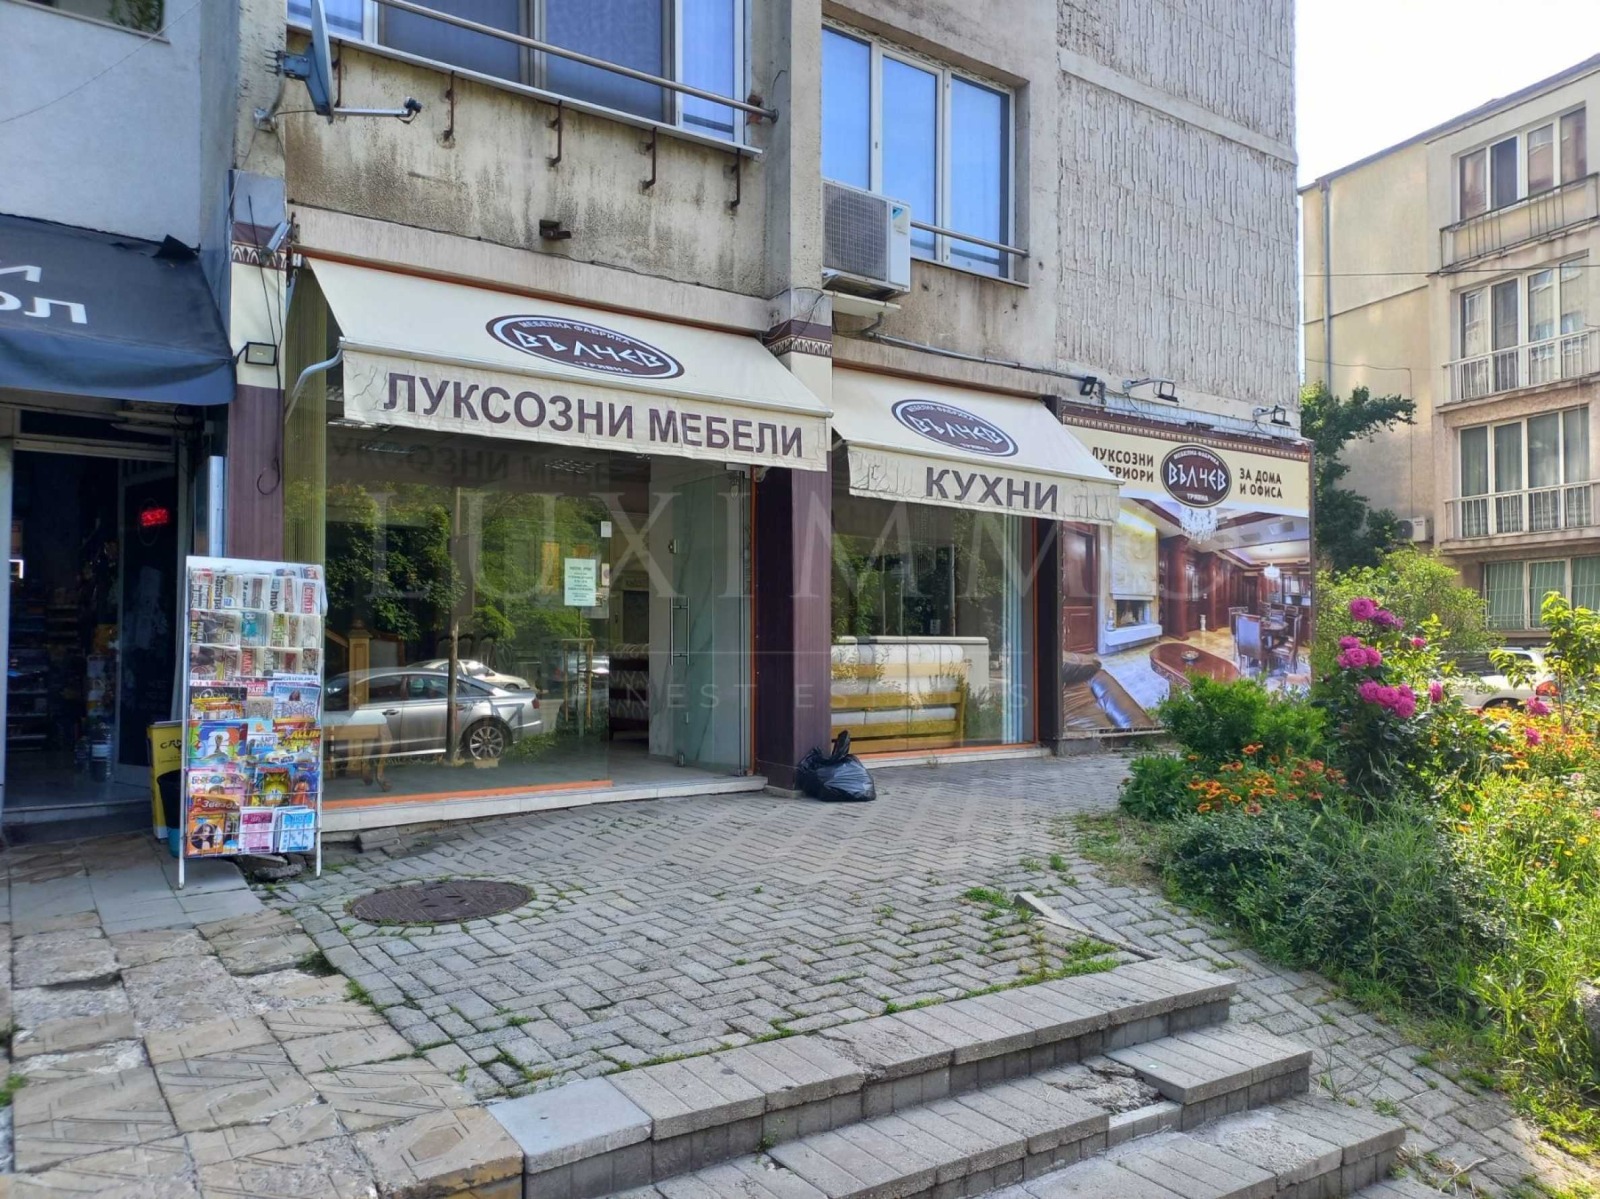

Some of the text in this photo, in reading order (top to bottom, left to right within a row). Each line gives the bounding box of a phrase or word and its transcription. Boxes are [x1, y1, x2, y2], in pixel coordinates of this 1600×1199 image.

[518, 321, 631, 346] МЕБЕЛНА ФАБРИКА
[511, 328, 664, 368] ВЪЛЧЕВ
[383, 372, 802, 458] ЛУКСОЗНИ МЕБЕЛИ
[906, 414, 1003, 444] ВЪЛЧЕВ
[1092, 446, 1154, 468] ЛУКСОЗНИ
[1104, 464, 1154, 483] ЕРИОРИ
[1168, 461, 1227, 492] ВЪЛЧЕВ
[1239, 467, 1282, 485] ЗА ДОМА
[926, 467, 1058, 512] КУХНИ
[1239, 483, 1283, 499] И ОФИСА
